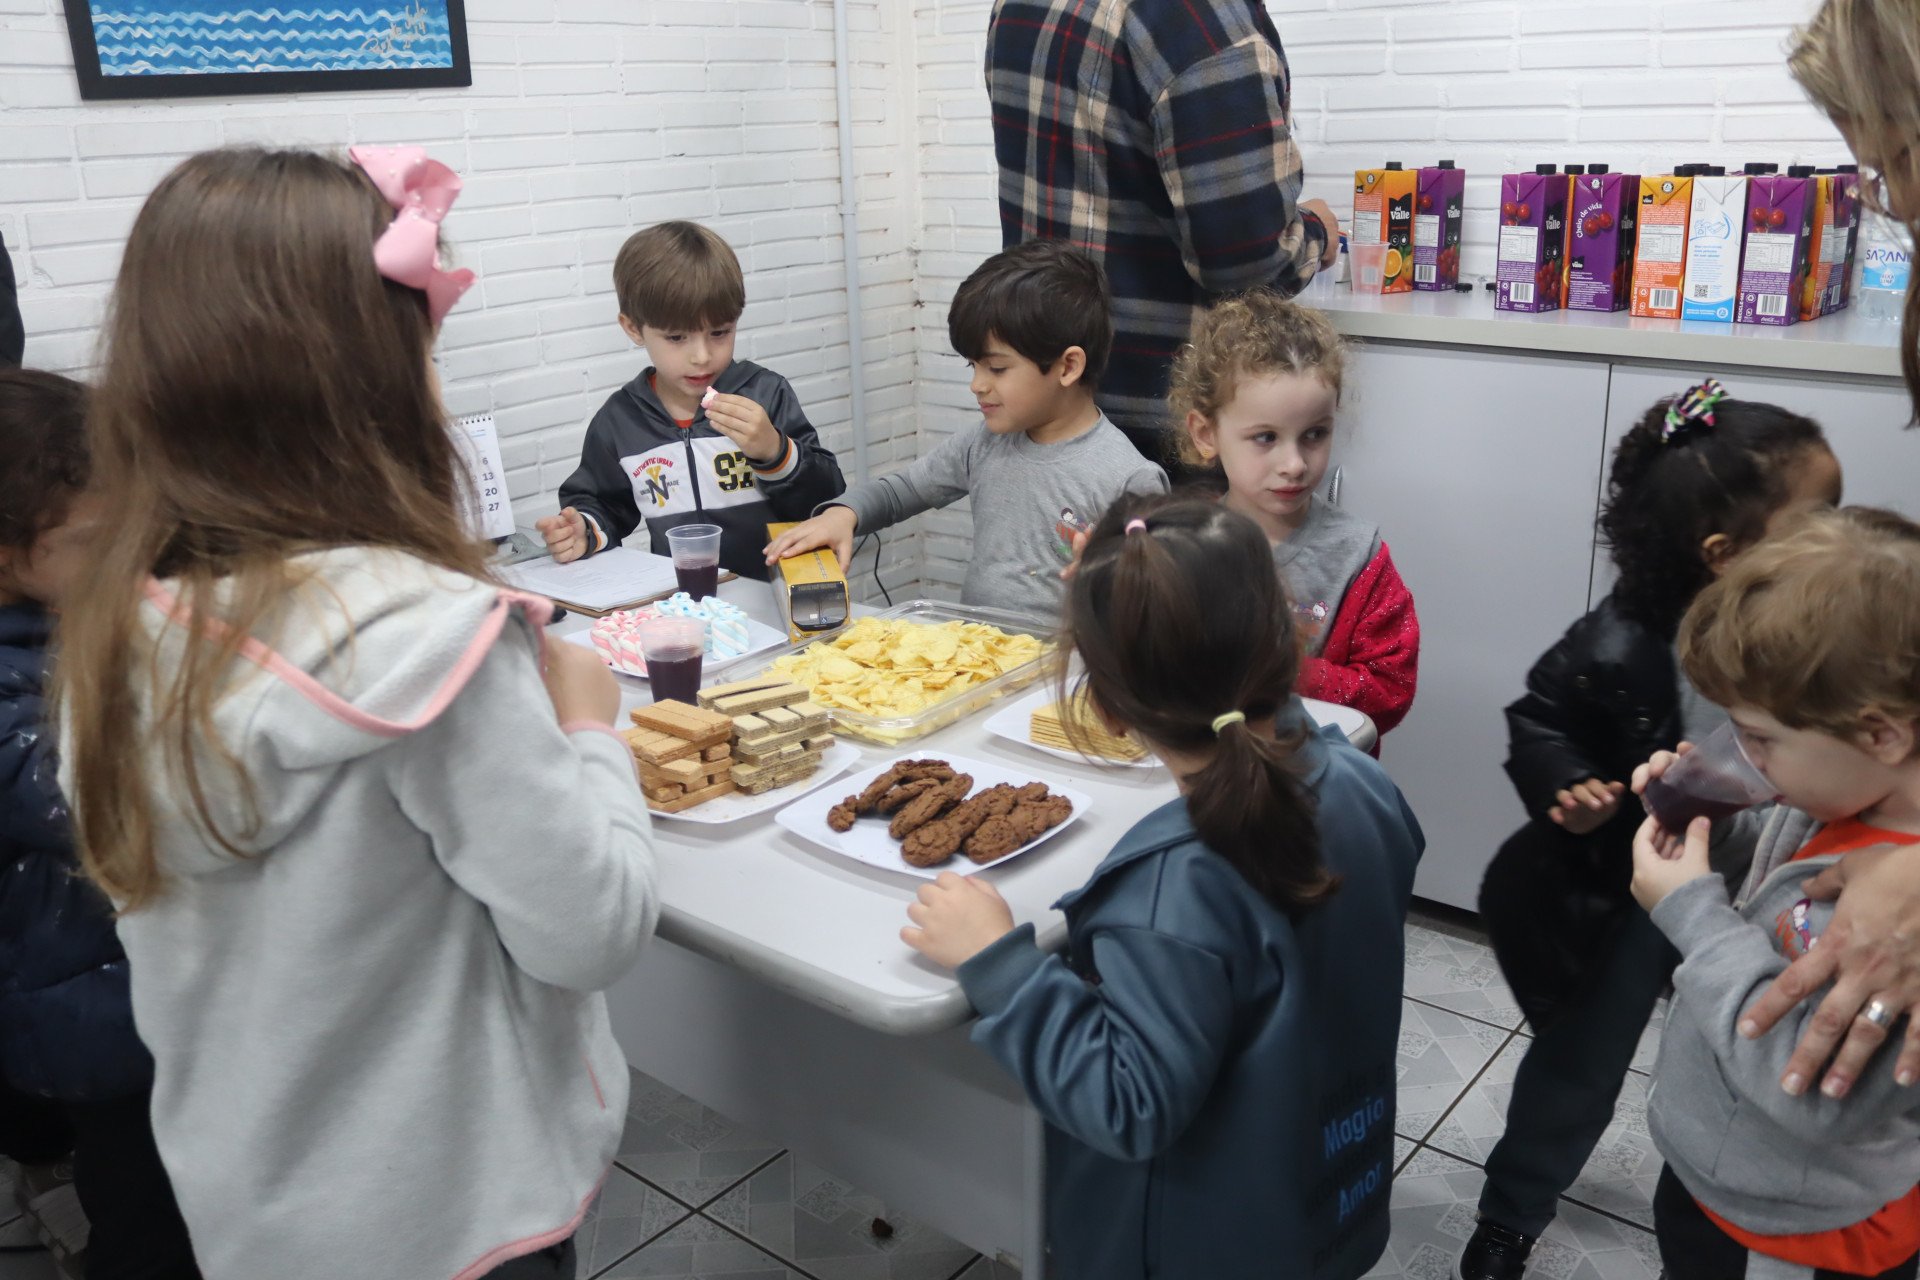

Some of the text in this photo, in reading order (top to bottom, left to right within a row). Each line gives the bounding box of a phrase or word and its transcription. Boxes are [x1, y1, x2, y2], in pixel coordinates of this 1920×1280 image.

[1390, 210, 1410, 220] Valle
[1580, 209, 1589, 218] de
[1588, 202, 1603, 212] vida
[1546, 219, 1561, 230] Valle
[1866, 249, 1911, 268] SARAN
[482, 457, 489, 465] 6
[632, 457, 674, 478] AUTHENTIC URBAN
[483, 472, 494, 481] 13
[485, 487, 498, 496] 20
[645, 474, 669, 505] N
[488, 502, 500, 512] 27
[1338, 1161, 1383, 1224] Amor
